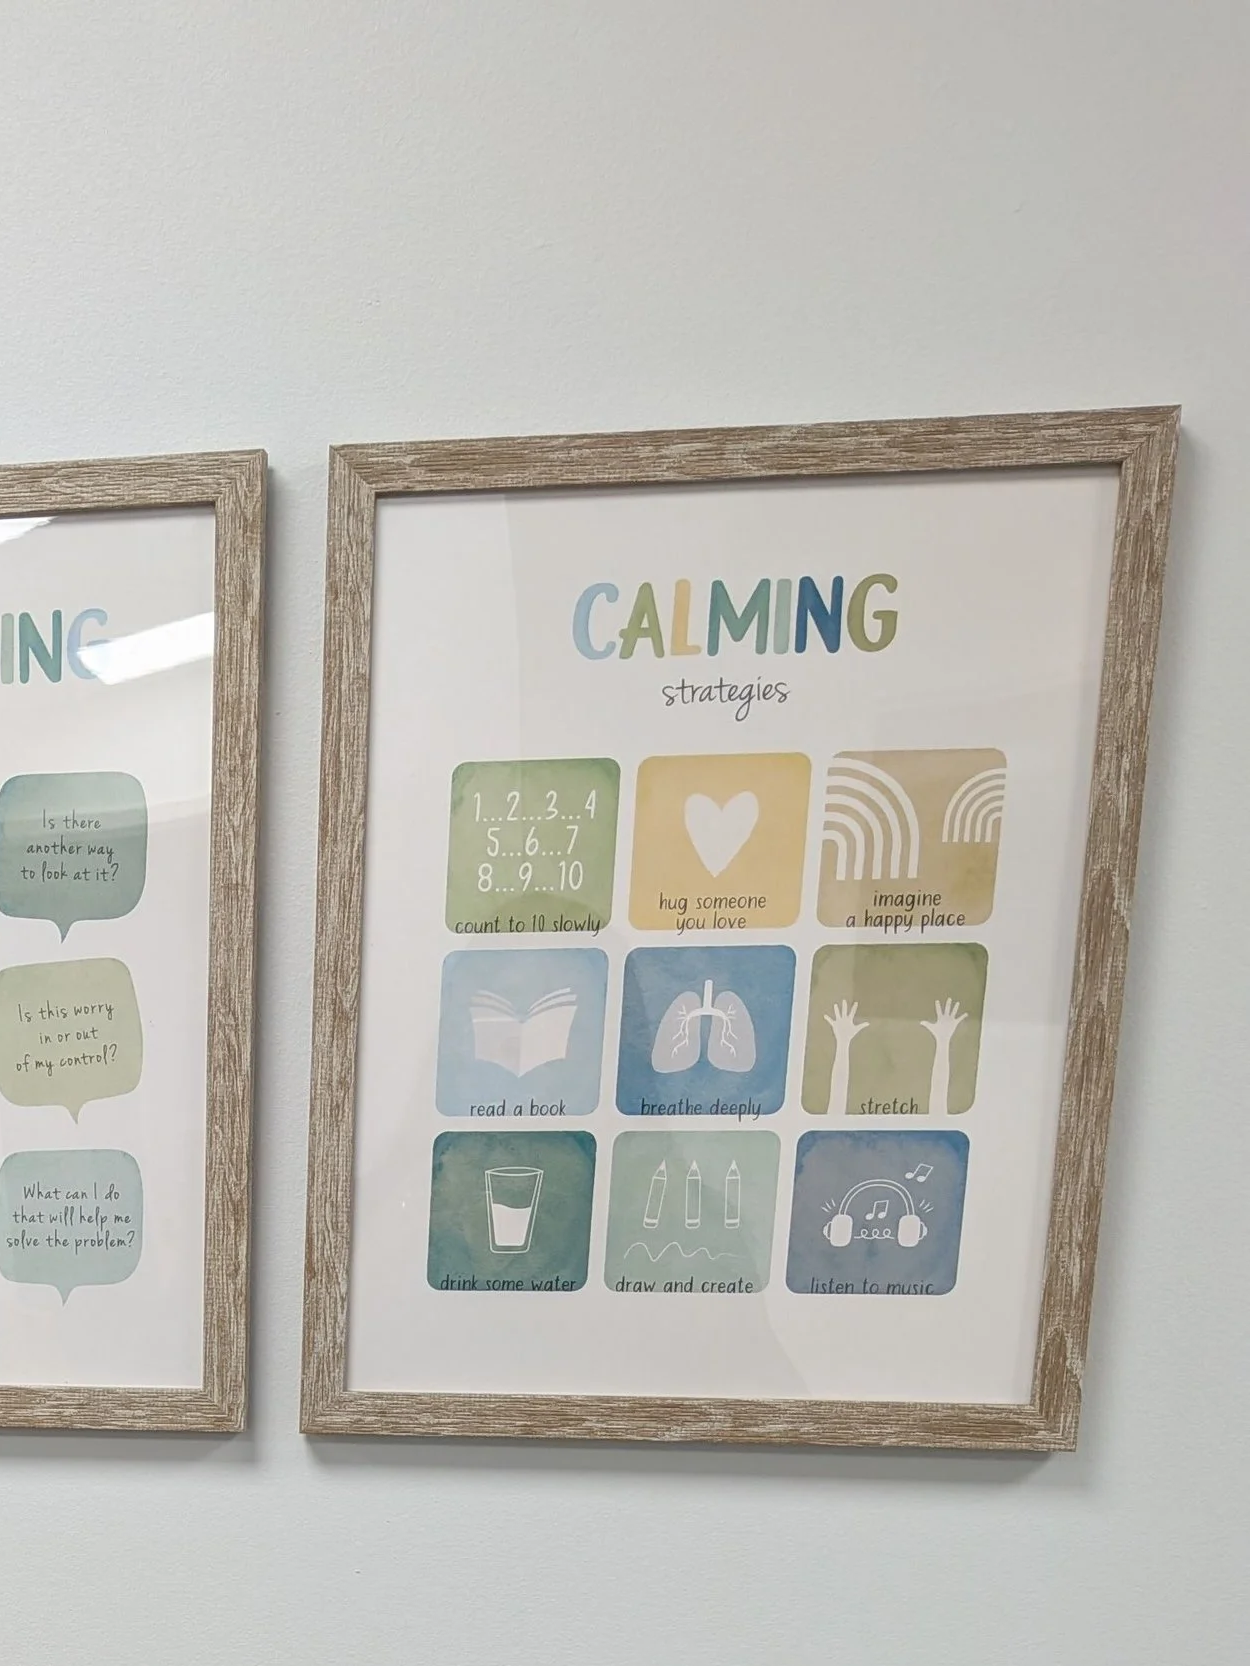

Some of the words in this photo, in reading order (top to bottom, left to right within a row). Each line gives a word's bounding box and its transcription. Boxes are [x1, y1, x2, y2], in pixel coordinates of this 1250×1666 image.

[572, 573, 899, 661] CALMING
[661, 675, 791, 723] strategies
[42, 808, 56, 830] Is
[62, 809, 102, 830] there
[26, 834, 83, 856] another
[87, 844, 115, 865] way
[20, 865, 36, 880] to
[41, 860, 69, 883] look
[73, 867, 91, 882] at
[95, 862, 119, 882] it?
[659, 891, 688, 916] hug
[695, 895, 767, 910] someone
[873, 889, 942, 913] imagine
[454, 917, 502, 935] count
[506, 915, 528, 934] to
[531, 914, 548, 933] 10
[551, 913, 603, 937] slowly
[676, 917, 707, 936] you
[712, 910, 747, 930] love
[845, 915, 858, 929] a
[861, 911, 915, 935] happy
[920, 907, 967, 935] place
[469, 1101, 512, 1119] read
[517, 1103, 528, 1118] a
[532, 1100, 567, 1118] book
[640, 1099, 704, 1118] breathe
[707, 1099, 762, 1122] deeply
[860, 1099, 920, 1116] stretch
[440, 1275, 483, 1292] drink
[485, 1278, 528, 1292] some
[529, 1277, 578, 1292] water
[615, 1277, 659, 1294] draw
[662, 1277, 696, 1294] and
[699, 1278, 755, 1294] create
[809, 1276, 856, 1296] listen
[860, 1277, 882, 1295] to
[885, 1278, 935, 1296] music
